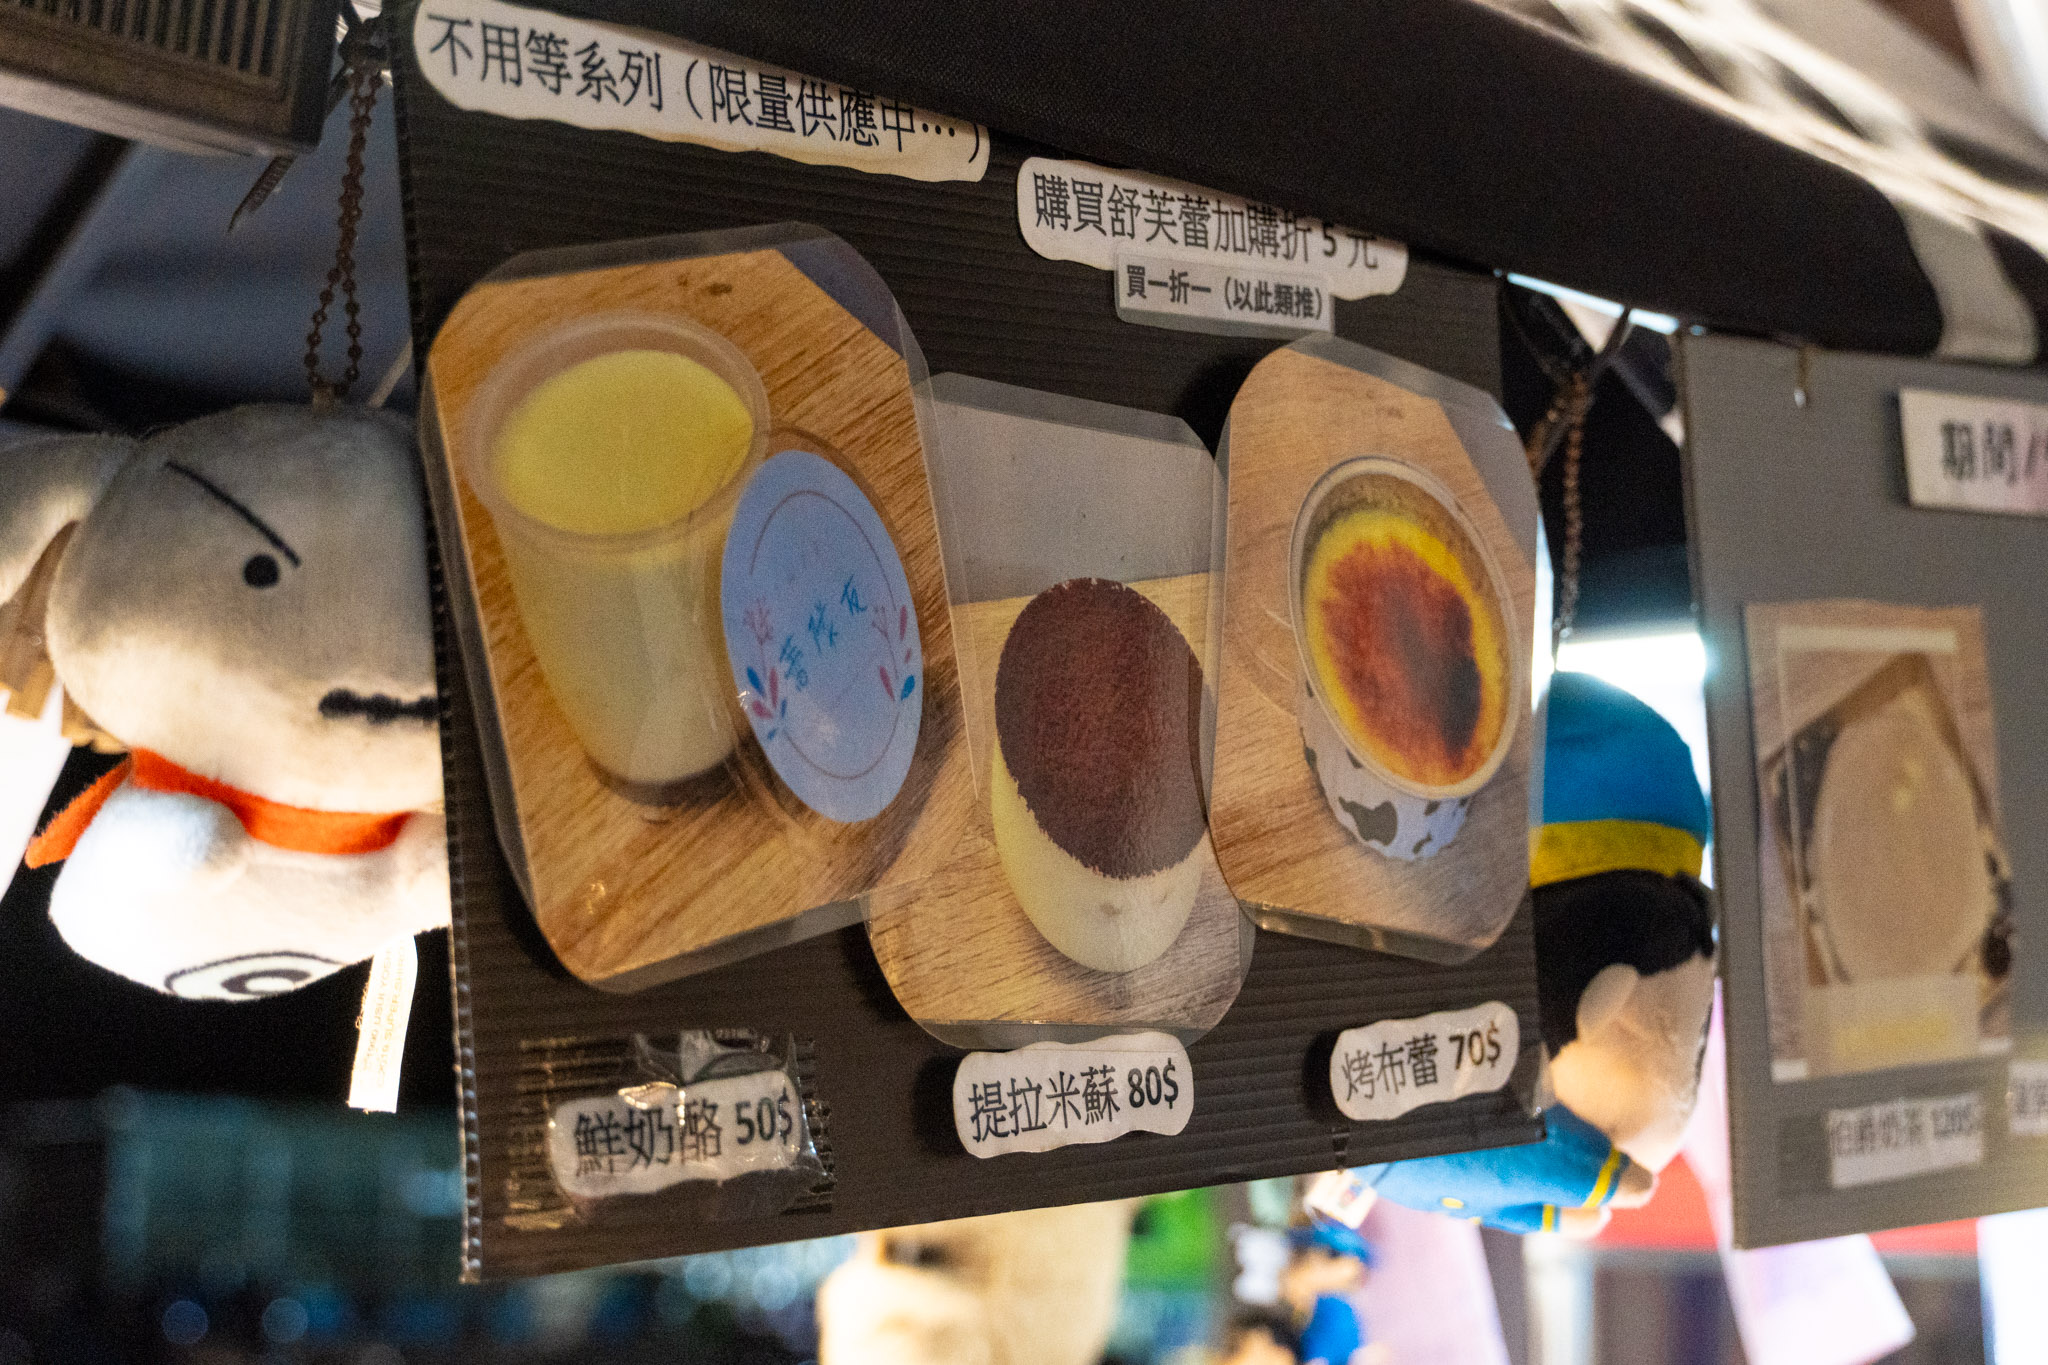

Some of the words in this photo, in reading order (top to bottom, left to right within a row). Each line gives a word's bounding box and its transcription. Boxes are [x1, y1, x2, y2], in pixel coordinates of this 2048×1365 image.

[969, 1064, 1120, 1143] 提拉米蘇
[1128, 1058, 1179, 1109] 80$
[1341, 1032, 1438, 1101] 烤布蕾
[1449, 1020, 1501, 1069] 70$
[574, 1098, 723, 1177] 鮮奶酪
[736, 1087, 793, 1145] 50$
